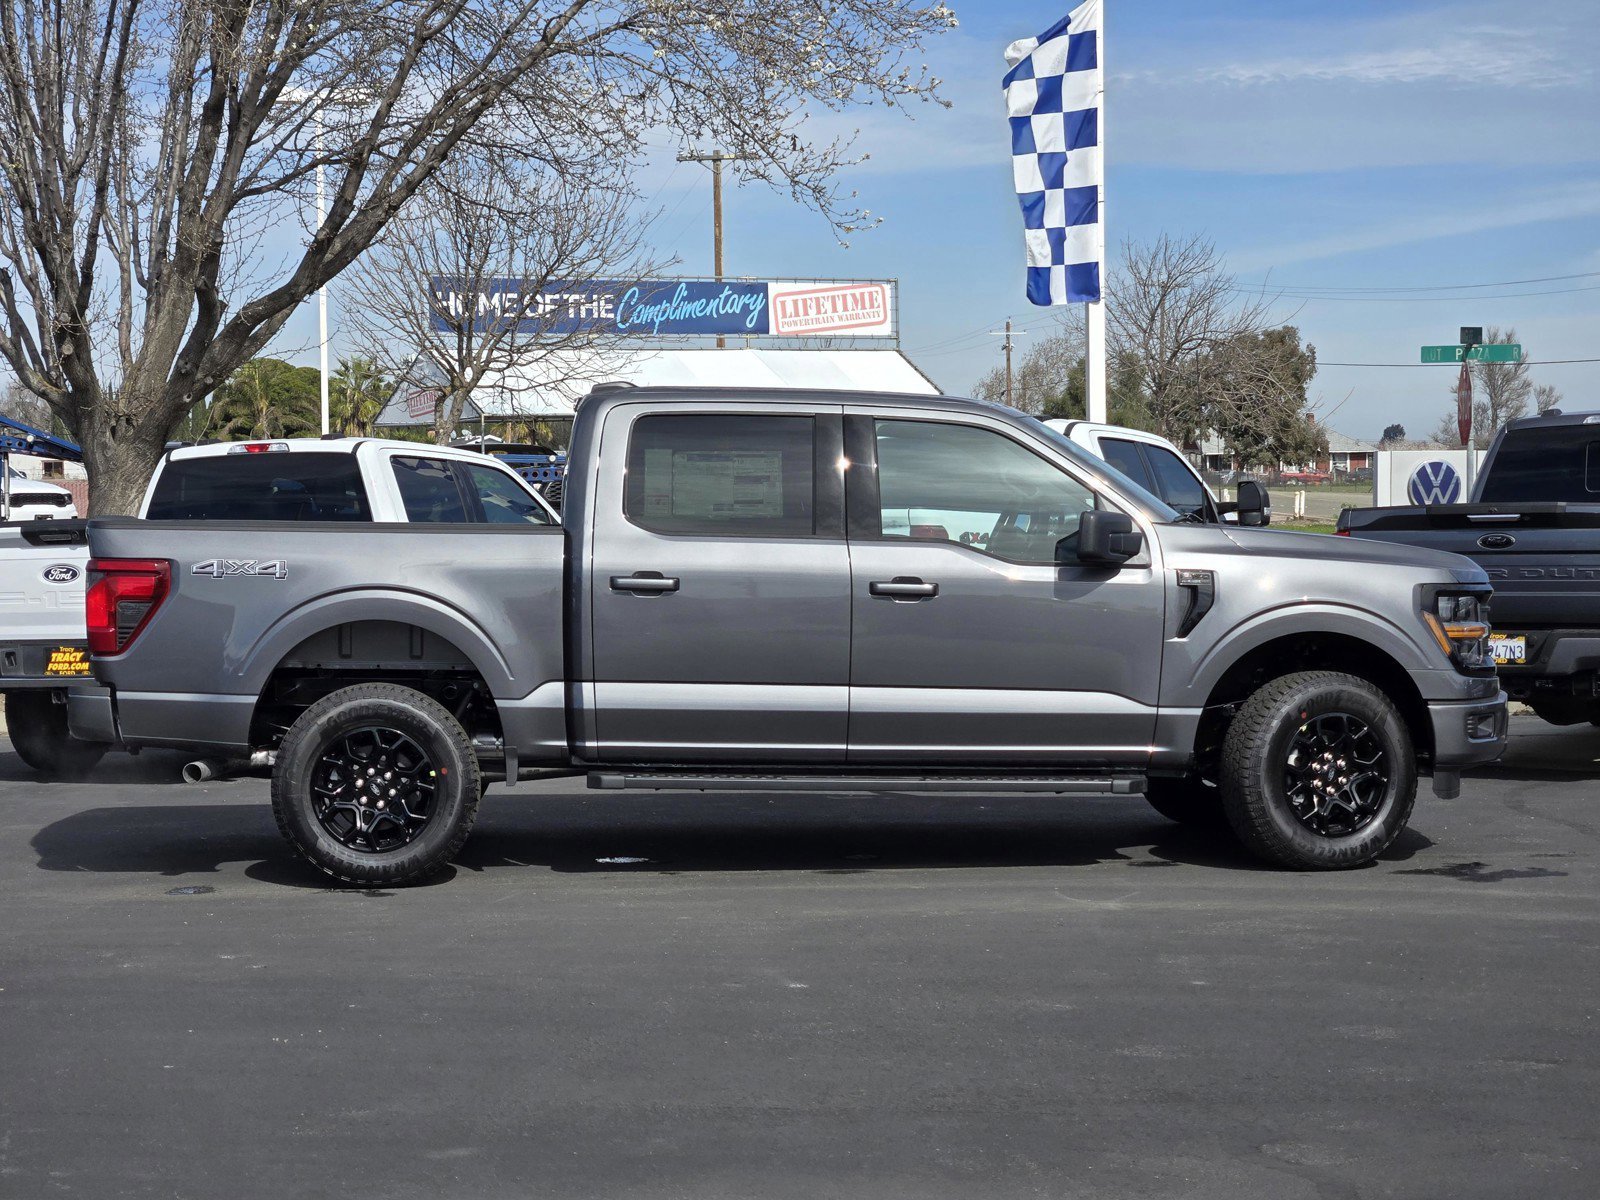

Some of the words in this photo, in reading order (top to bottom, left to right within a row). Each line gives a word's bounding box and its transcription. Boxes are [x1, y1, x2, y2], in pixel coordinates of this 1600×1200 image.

[562, 293, 615, 319] THE
[616, 282, 766, 336] Complimentary
[779, 290, 881, 320] LIFETIME
[781, 316, 835, 329] POWERTRAIN
[838, 310, 881, 322] WARRANTY
[1455, 347, 1490, 361] PAZA
[48, 567, 74, 580] Ford
[51, 652, 85, 662] TRACY
[47, 662, 90, 671] FORD.COM
